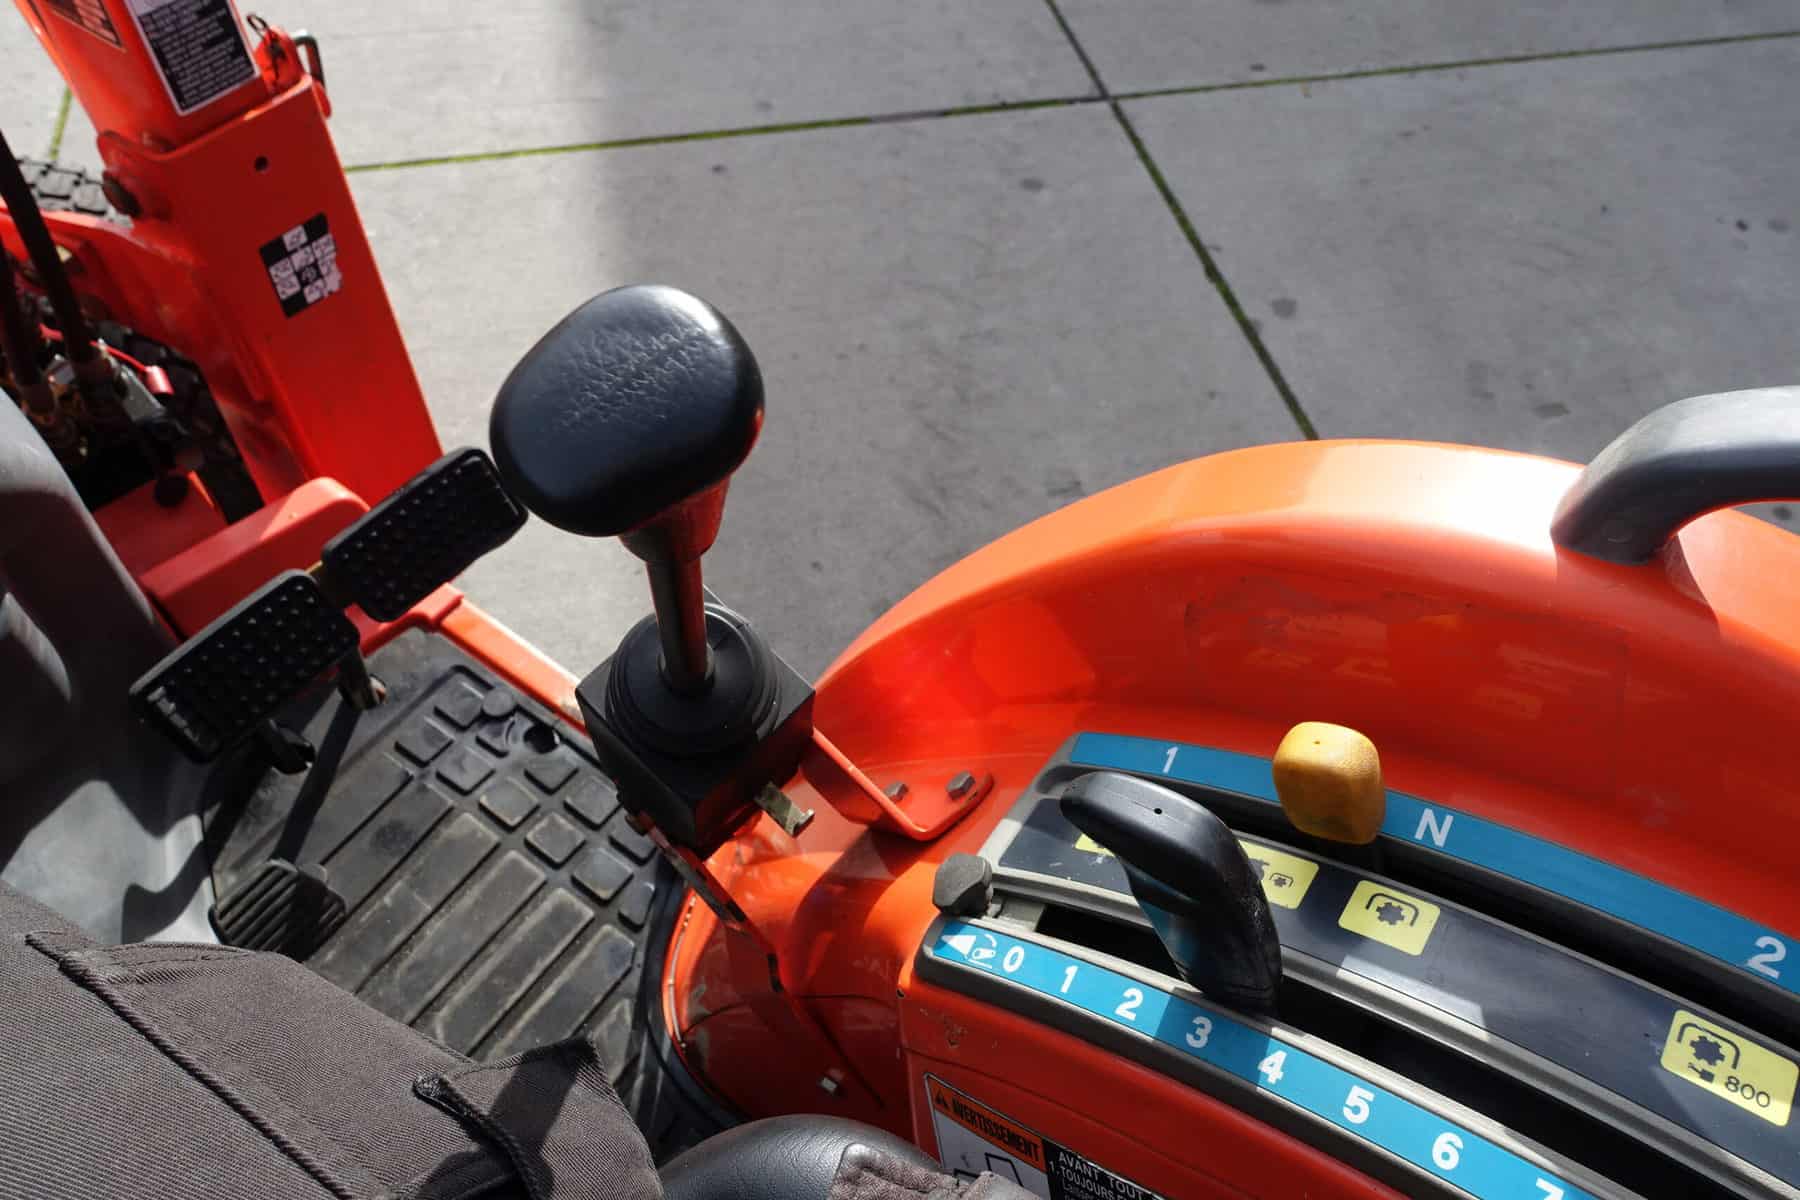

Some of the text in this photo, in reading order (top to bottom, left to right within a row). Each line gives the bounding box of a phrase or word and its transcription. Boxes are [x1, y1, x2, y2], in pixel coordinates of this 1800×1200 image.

[1163, 747, 1787, 979] 1 N 2
[1003, 945, 1565, 1200] 0 1 2 3 4 5 6 7
[1724, 1075, 1771, 1108] 800
[952, 1097, 1040, 1162] AVERTISSEMENT
[1059, 1151, 1099, 1181] AVANT
[1108, 1176, 1144, 1200] TOUT
